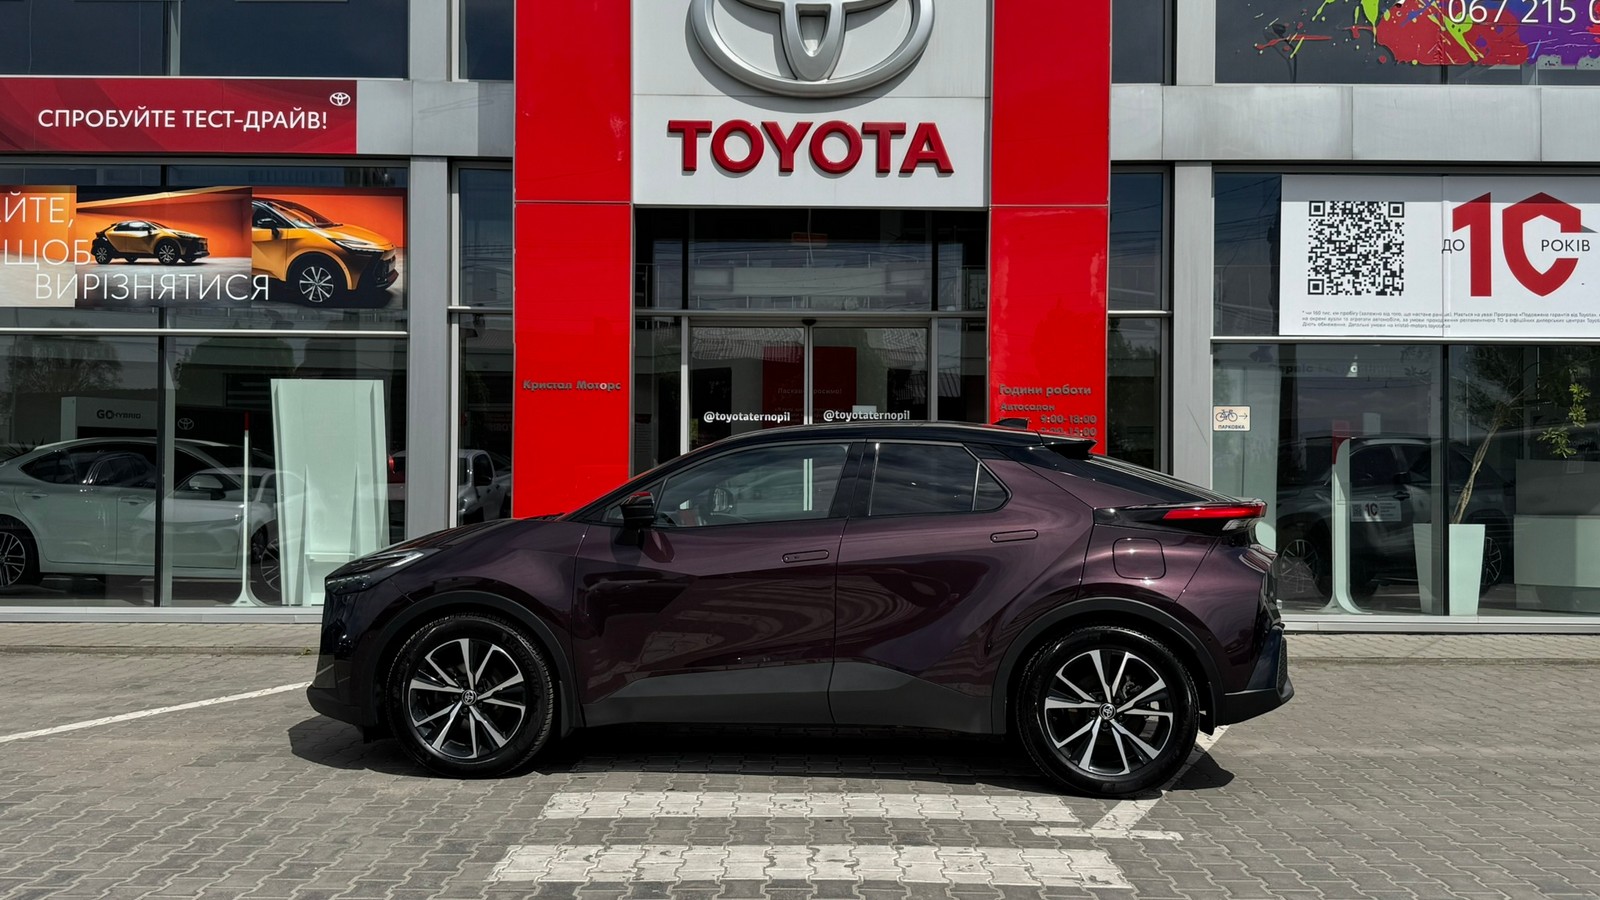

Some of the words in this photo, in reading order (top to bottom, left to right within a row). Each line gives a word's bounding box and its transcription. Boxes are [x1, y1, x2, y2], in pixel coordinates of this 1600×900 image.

[1448, 0, 1508, 23] 067
[1521, 0, 1576, 23] 215
[37, 106, 176, 129] СПРОБУЙТЕ
[181, 107, 328, 132] ТЕСТ-ДРАЙВ!
[667, 118, 954, 175] TOYOTA
[0, 190, 75, 228] ЙТЕ,
[3, 238, 92, 271] ЩОБ
[1441, 238, 1465, 254] ДО
[1540, 239, 1591, 252] РОКІВ
[35, 273, 271, 302] ВИРІЗНЯТИСЯ
[522, 380, 572, 392] Кристал
[576, 380, 621, 392] Моторс
[999, 384, 1043, 396] Години
[1046, 384, 1092, 398] роботи
[823, 410, 910, 422] @toyotaternopil
[1000, 402, 1055, 411] Автосалон
[703, 411, 791, 424] @toyotaternopil
